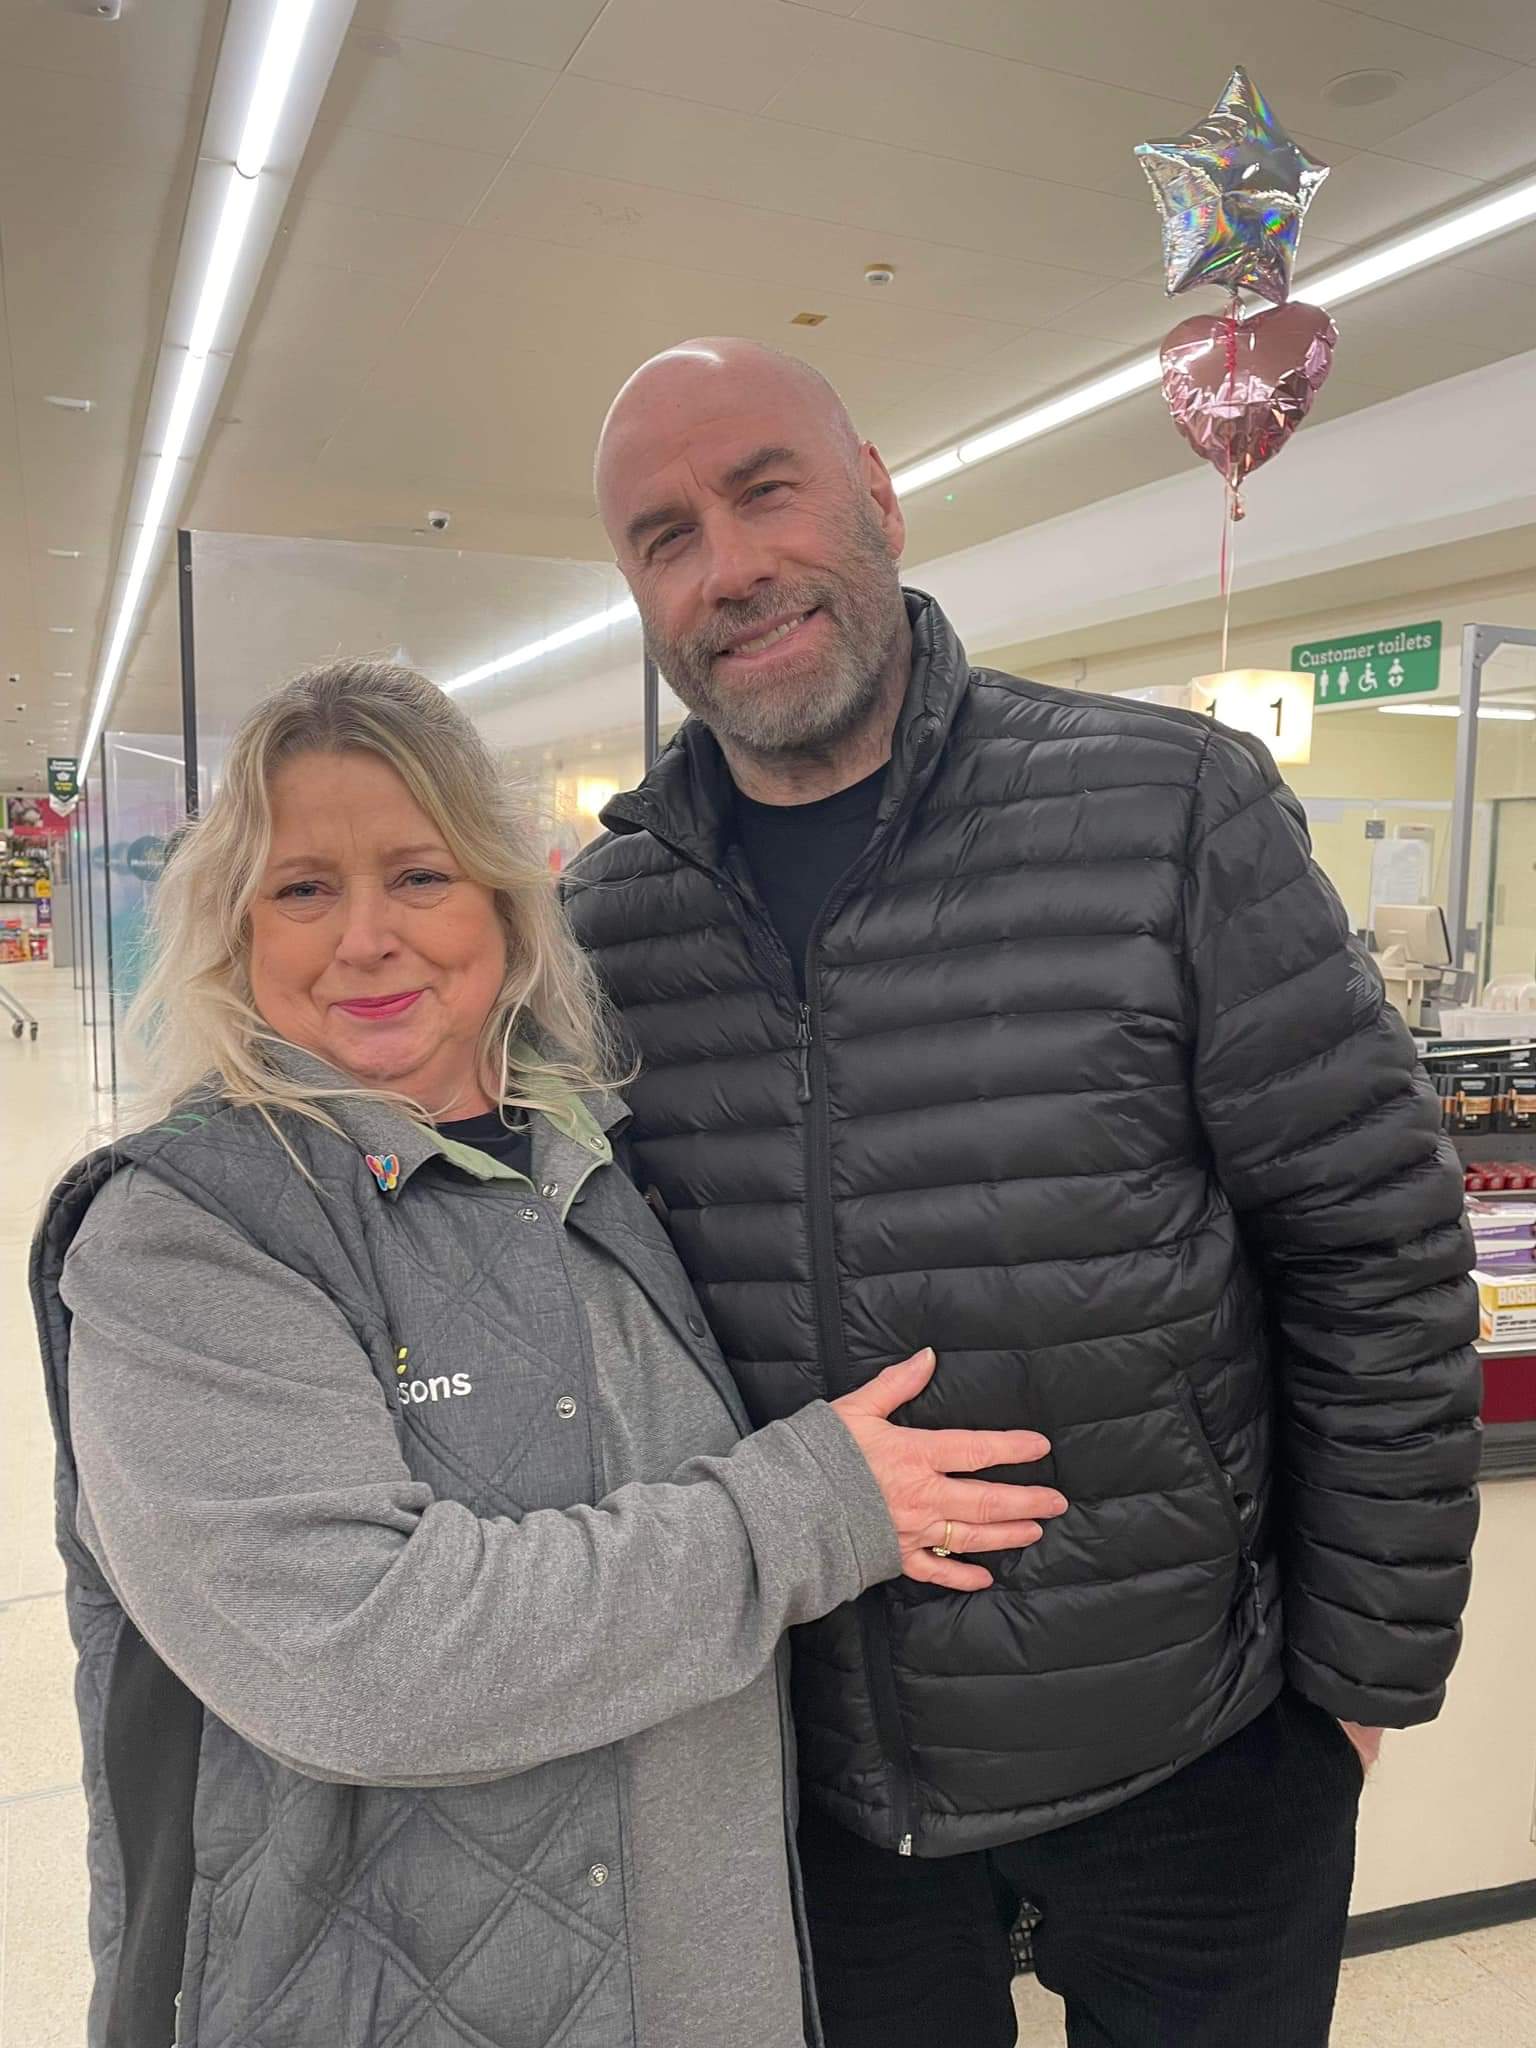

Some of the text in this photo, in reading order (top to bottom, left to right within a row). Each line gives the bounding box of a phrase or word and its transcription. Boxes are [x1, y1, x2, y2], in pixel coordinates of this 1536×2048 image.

[1299, 632, 1432, 668] Customer toilets
[1270, 698, 1282, 736] 1
